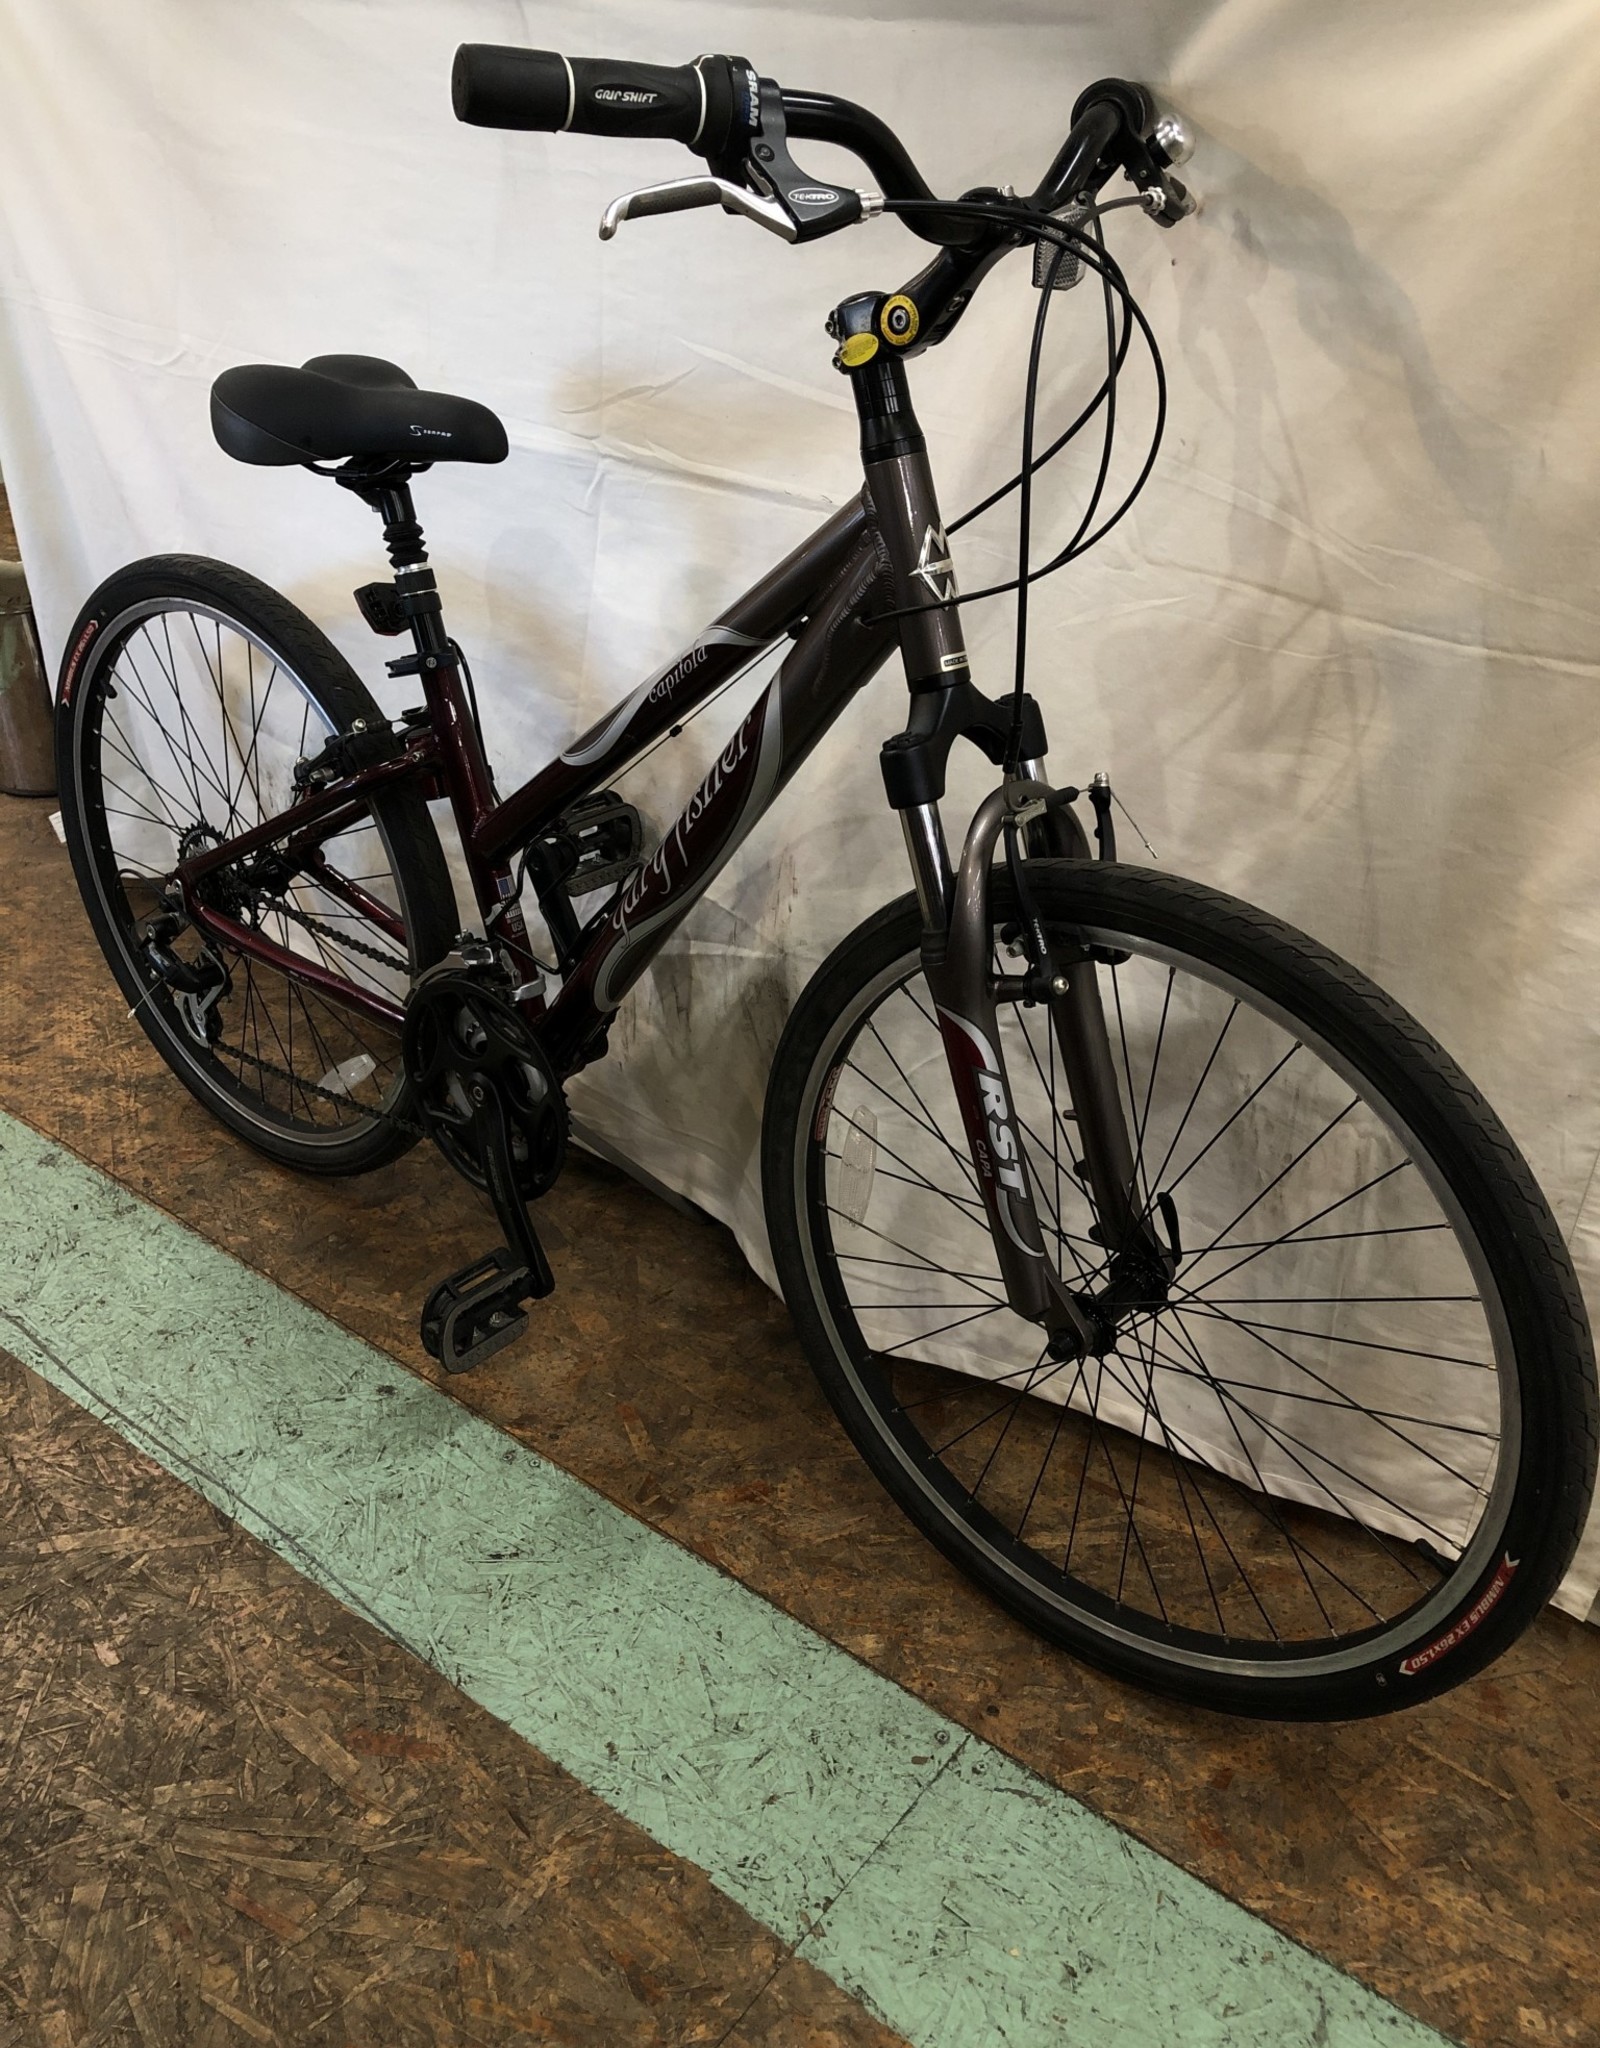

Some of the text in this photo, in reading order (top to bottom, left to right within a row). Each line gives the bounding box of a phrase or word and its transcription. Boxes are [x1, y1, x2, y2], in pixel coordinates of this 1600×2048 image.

[594, 88, 658, 104] GRIP SHIFT
[745, 69, 759, 127] SRAM
[792, 192, 835, 201] TEKTRO
[648, 639, 708, 703] capitola
[612, 844, 671, 947] gary
[1033, 917, 1048, 955] TEKTRO
[975, 1139, 993, 1179] CAPA
[977, 1072, 1028, 1200] RST
[1411, 1576, 1505, 1669] NIMBUS EX 26x1.50
